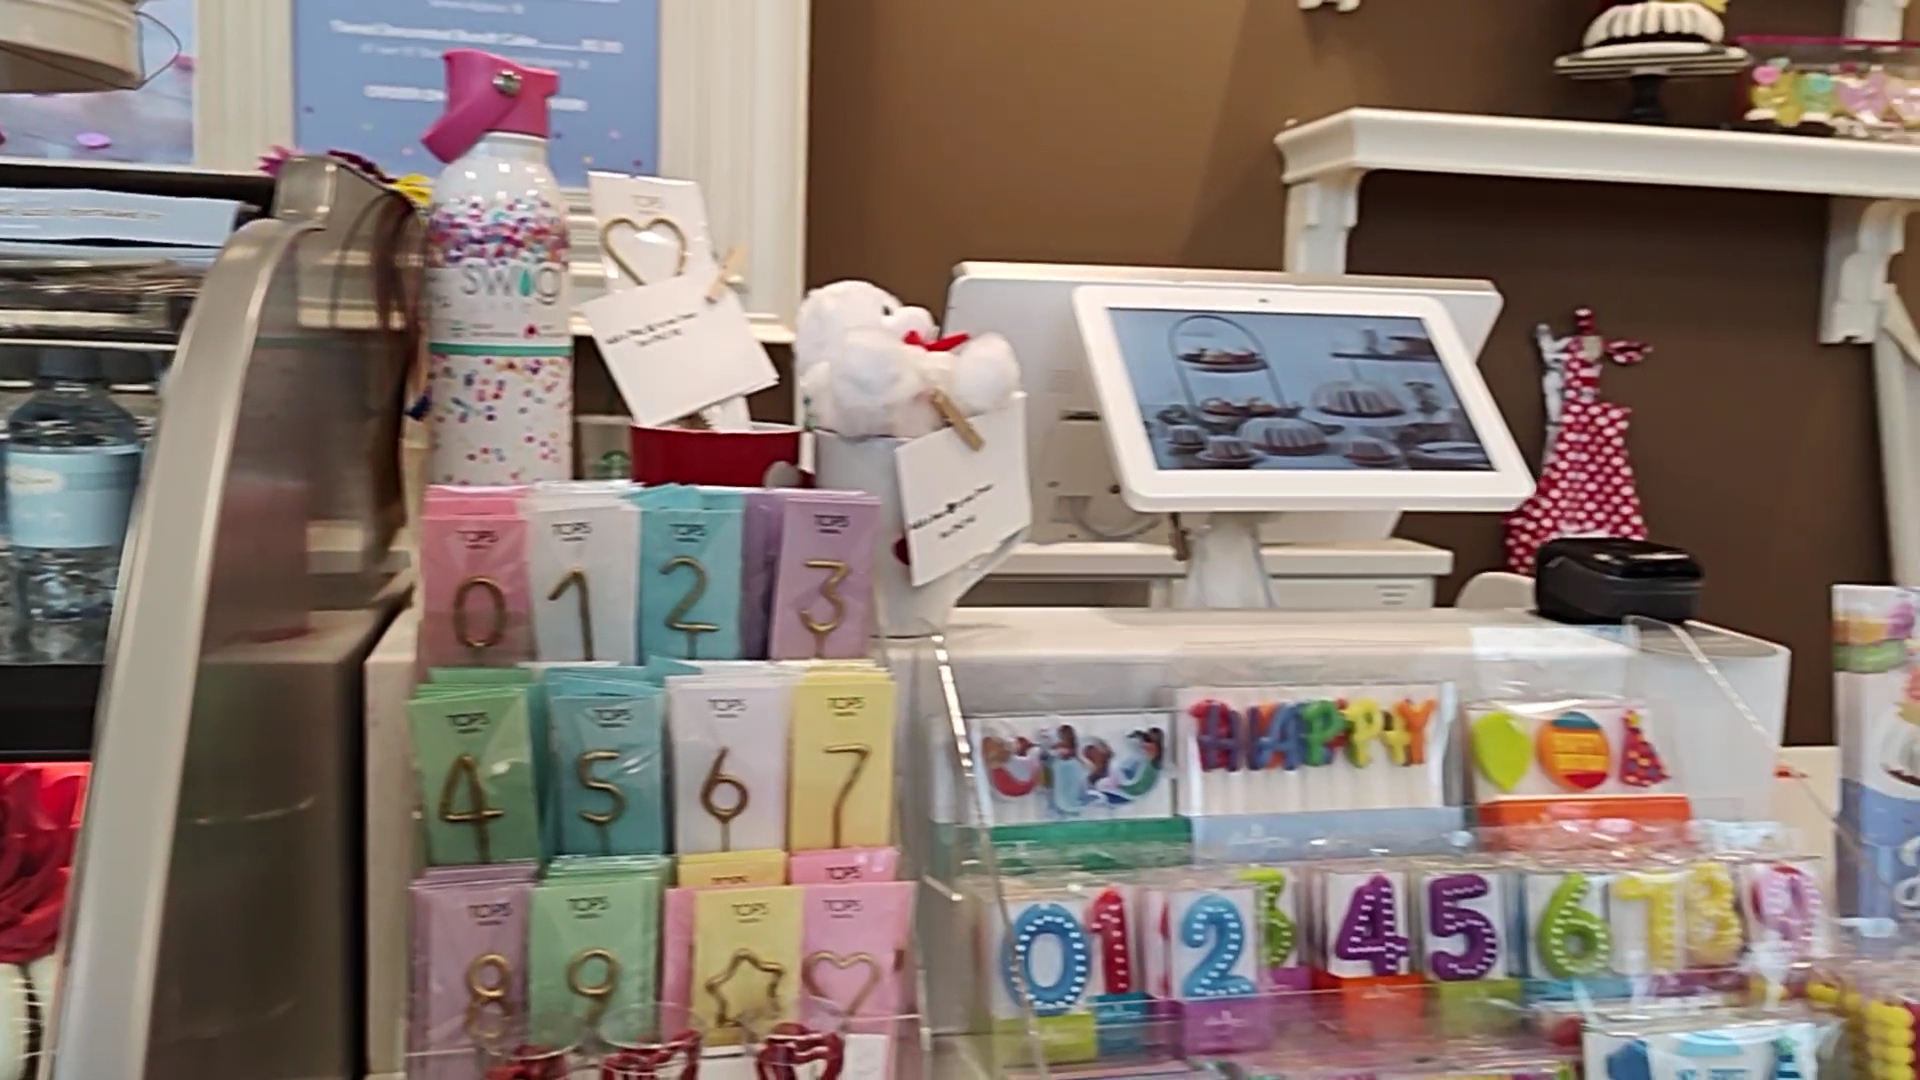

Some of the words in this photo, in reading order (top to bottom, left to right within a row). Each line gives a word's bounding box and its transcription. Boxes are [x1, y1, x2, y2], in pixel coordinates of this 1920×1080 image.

[547, 568, 595, 661] 1
[659, 555, 720, 633] 2
[800, 560, 851, 633] 3
[438, 755, 504, 833] 4
[577, 750, 626, 826] 5
[701, 746, 749, 824] 6
[823, 743, 873, 848] 7
[1086, 887, 1131, 993] 1
[1181, 892, 1257, 1000] 2
[1335, 873, 1410, 976] 4
[1427, 873, 1497, 980] 5
[1538, 872, 1611, 978] 6
[1615, 875, 1676, 972] 7
[466, 952, 515, 1040] 8
[567, 947, 621, 1026] 9
